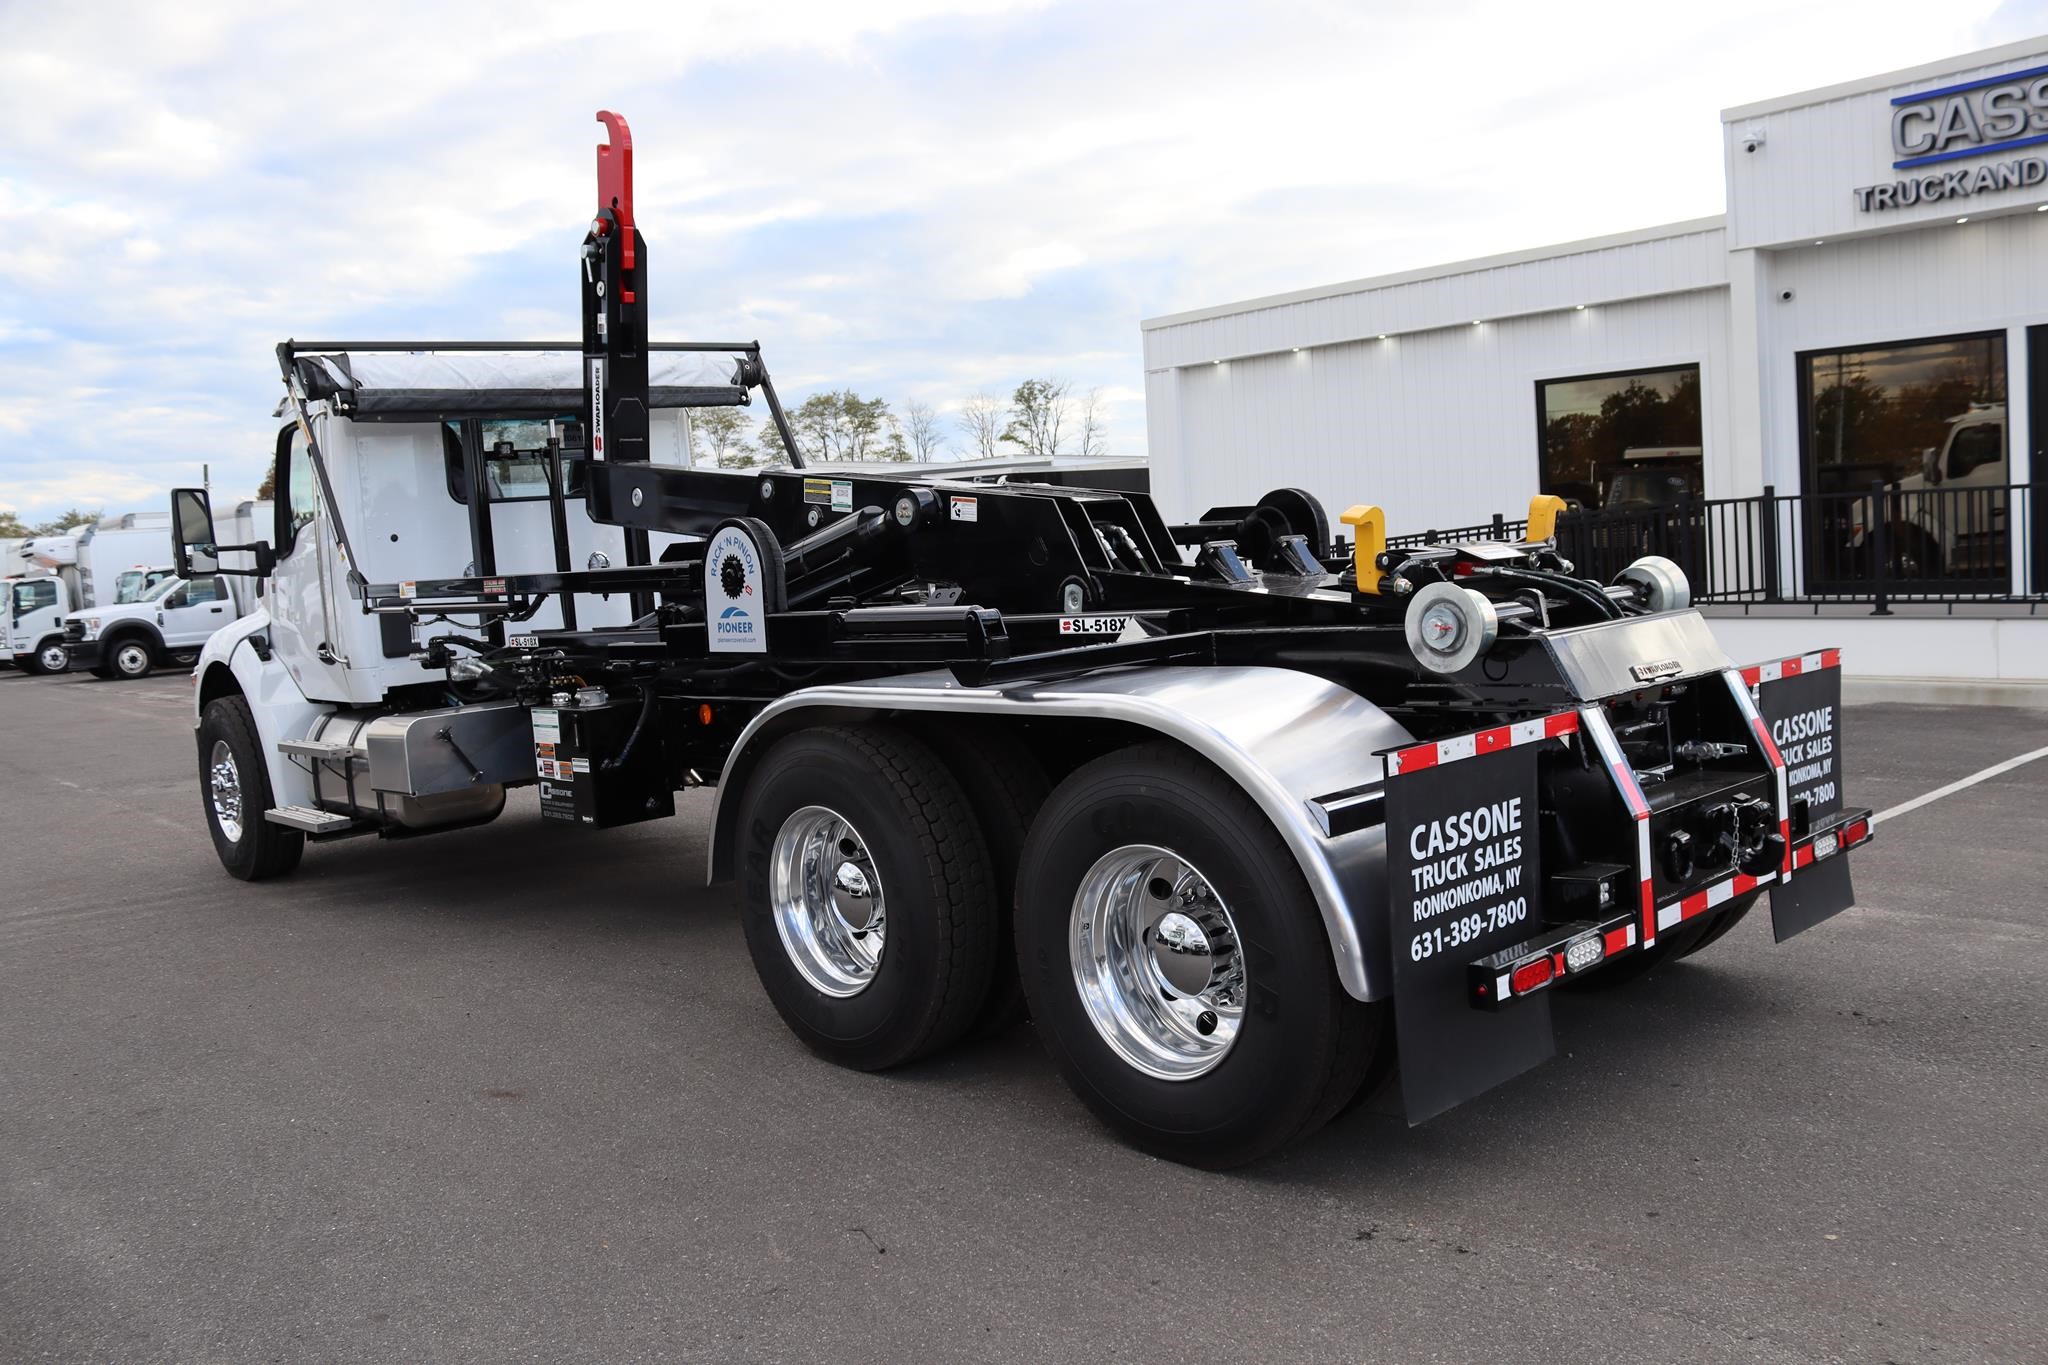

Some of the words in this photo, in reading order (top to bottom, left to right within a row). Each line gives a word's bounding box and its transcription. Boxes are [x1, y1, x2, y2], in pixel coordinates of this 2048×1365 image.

[711, 542, 726, 577] RACK
[733, 538, 755, 574] PINION
[515, 637, 537, 646] SL-518X
[717, 621, 753, 633] PIONEER
[1072, 618, 1127, 632] SL-518X
[1773, 706, 1832, 747] CASSONE
[1806, 736, 1832, 759] SALES
[1823, 758, 1833, 775] NY
[1410, 797, 1522, 860] CASSONE
[1411, 853, 1468, 893] TRUCK
[1474, 836, 1522, 872] SALES
[1413, 873, 1504, 923] RONKONKOMA,
[1506, 865, 1522, 890] NY
[1411, 896, 1527, 962] 631-389-7800
